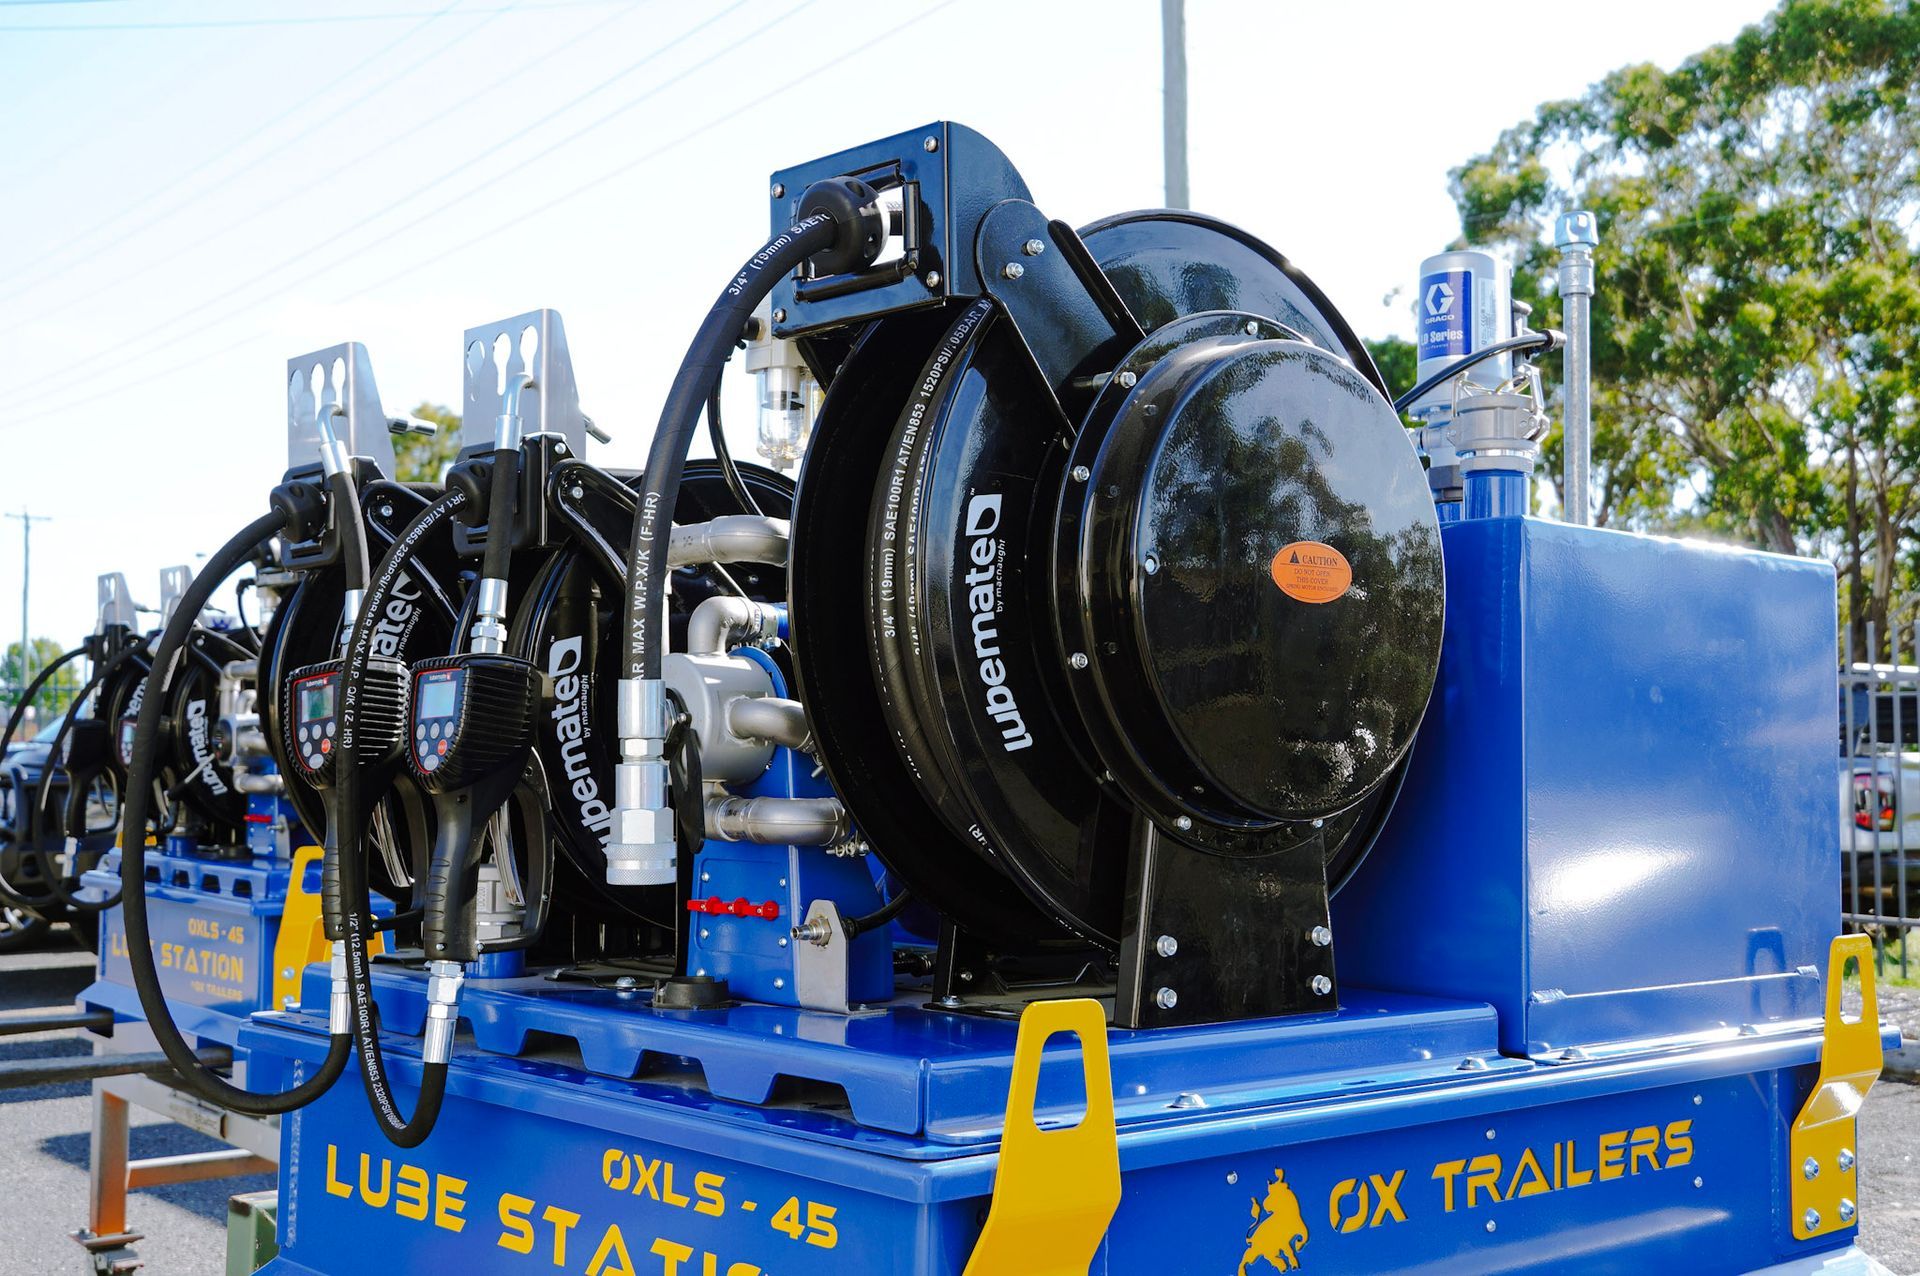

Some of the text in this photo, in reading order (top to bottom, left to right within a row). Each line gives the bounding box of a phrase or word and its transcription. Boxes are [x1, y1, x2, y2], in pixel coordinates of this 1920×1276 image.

[728, 271, 748, 296] 3/4"
[749, 234, 792, 270] (19mm)
[1424, 314, 1455, 325] GRACO
[1430, 329, 1463, 343] Series
[406, 504, 446, 545] AT/EN853
[884, 469, 906, 541] SAE100R1
[881, 548, 896, 602] (19mm)
[1302, 554, 1338, 567] CAUTION
[632, 617, 646, 654] MAX
[188, 918, 219, 941] OXLS
[227, 926, 245, 945] 45
[161, 942, 244, 983] STATION
[325, 1143, 468, 1233] LUBE
[1329, 1119, 1695, 1234] OX TRAILERS
[602, 1148, 726, 1218] OXLS
[770, 1196, 838, 1249] 45
